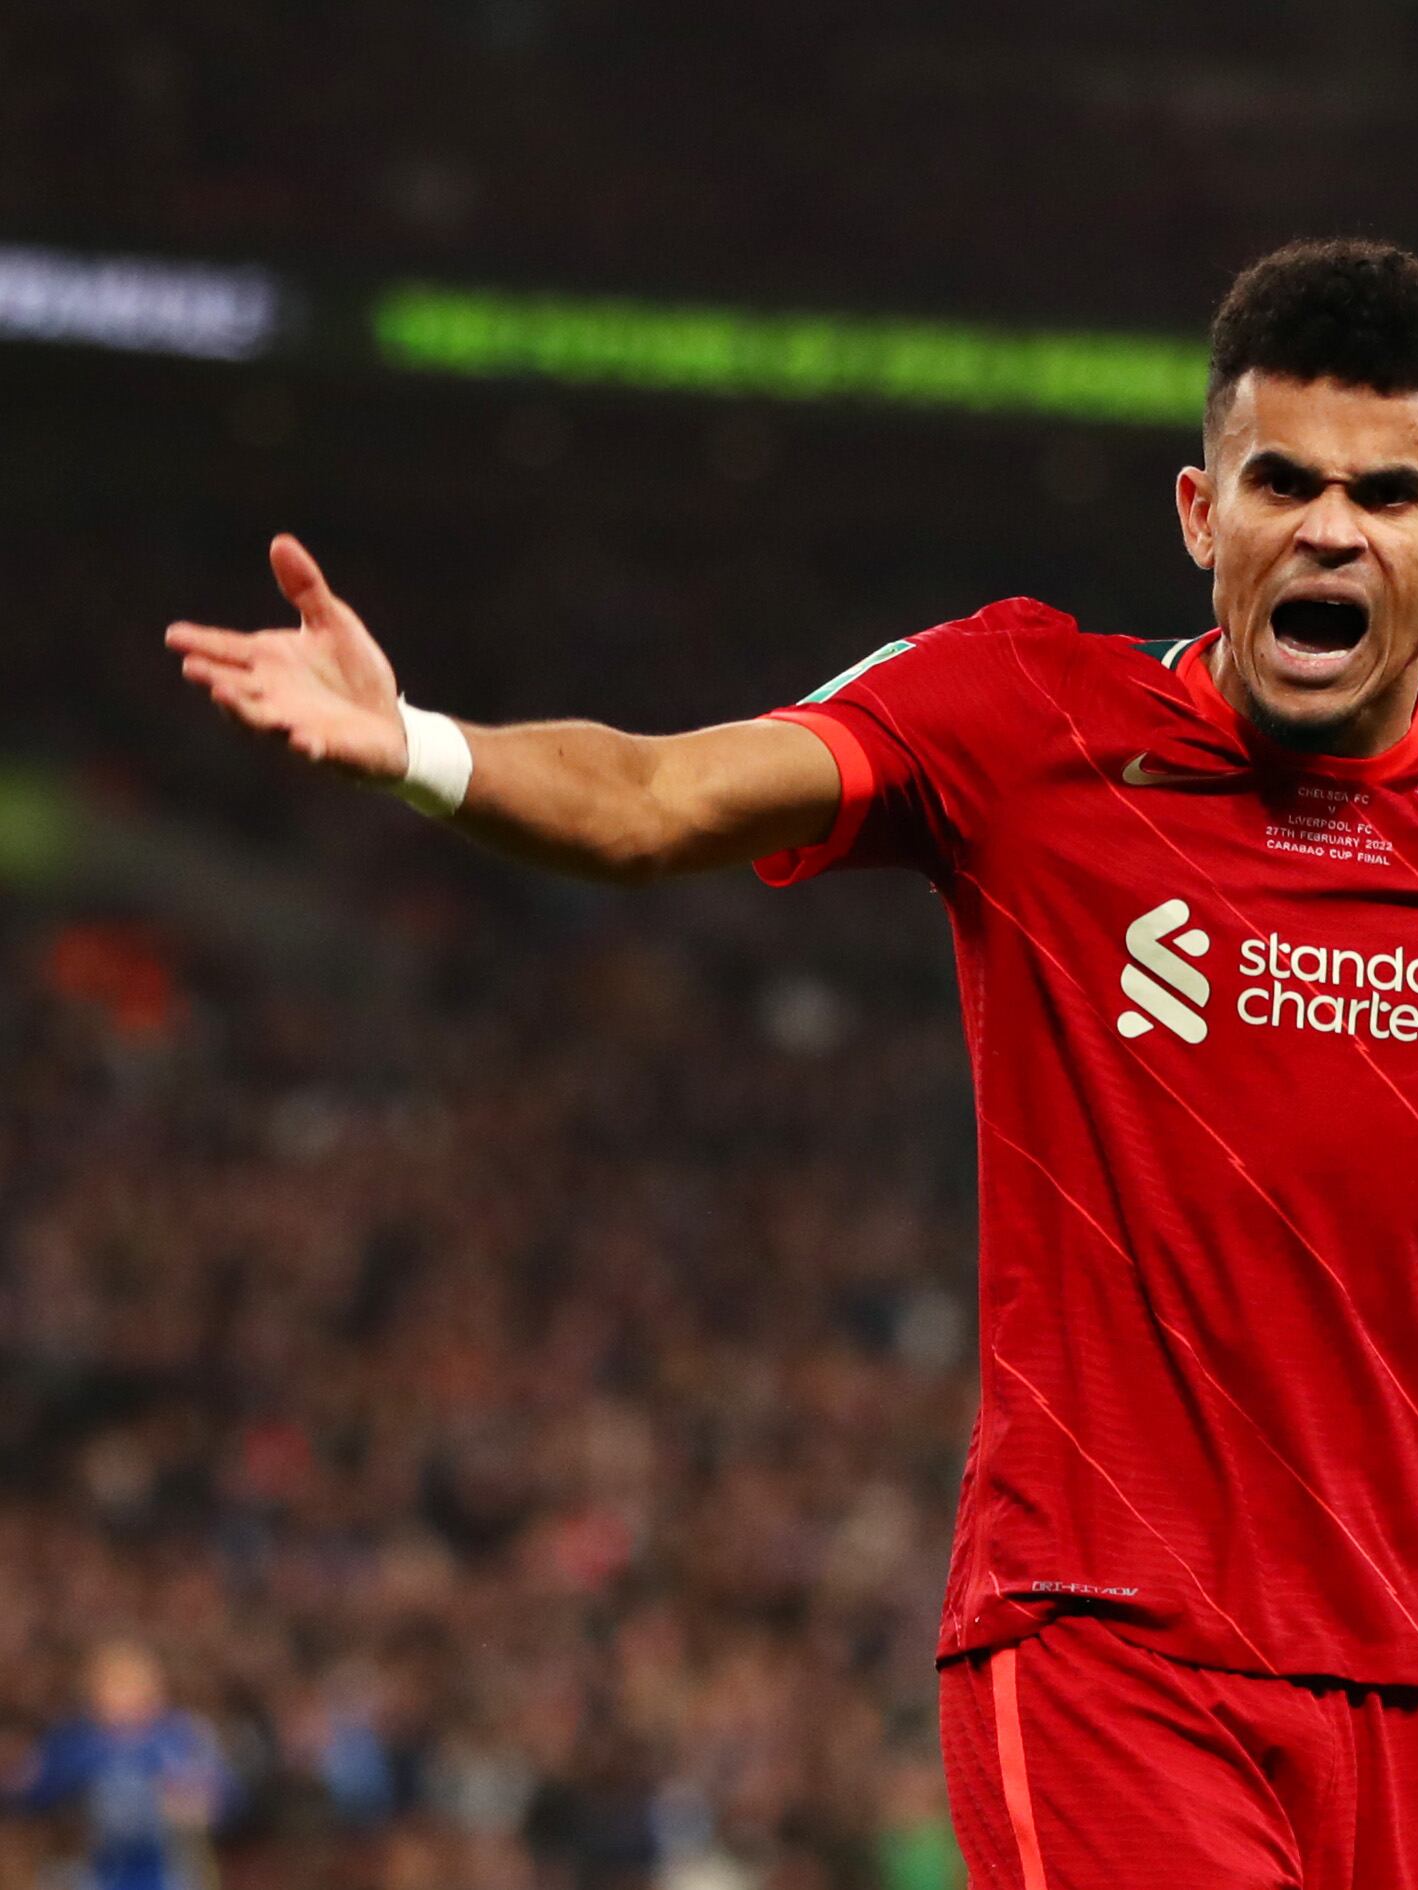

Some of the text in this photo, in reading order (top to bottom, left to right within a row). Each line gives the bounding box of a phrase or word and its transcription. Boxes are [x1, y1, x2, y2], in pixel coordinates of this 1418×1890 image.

[1298, 787, 1370, 804] CHELSEA FC
[1288, 815, 1373, 834] LIVERPOOL FC
[1266, 826, 1393, 851] 27TH FEBRUARY 2022
[1266, 840, 1391, 866] CARABAO CUP FINAL
